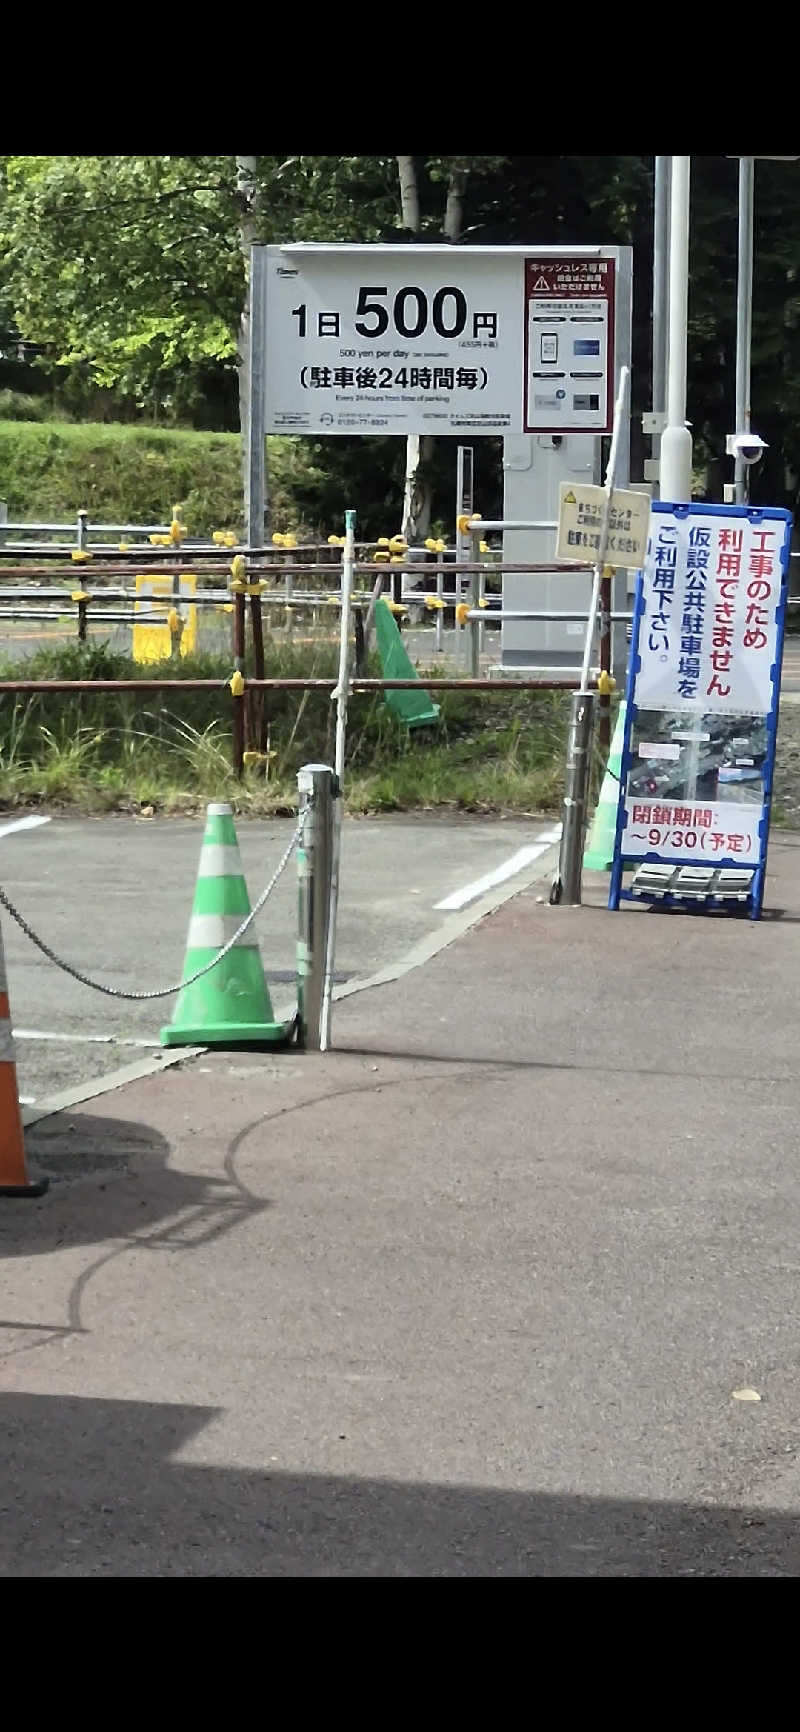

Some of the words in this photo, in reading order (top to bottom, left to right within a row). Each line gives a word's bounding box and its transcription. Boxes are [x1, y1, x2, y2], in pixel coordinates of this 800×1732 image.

[300, 366, 488, 390] (駐車後24時間毎)
[339, 349, 356, 358] 500
[358, 350, 374, 359] yen
[376, 350, 390, 359] per
[392, 349, 410, 359] day
[649, 525, 678, 663] ご利用下さい。
[676, 526, 712, 699] 仮設公共駐車場を
[706, 528, 744, 697] 利用できません
[742, 530, 776, 650] 工事のため
